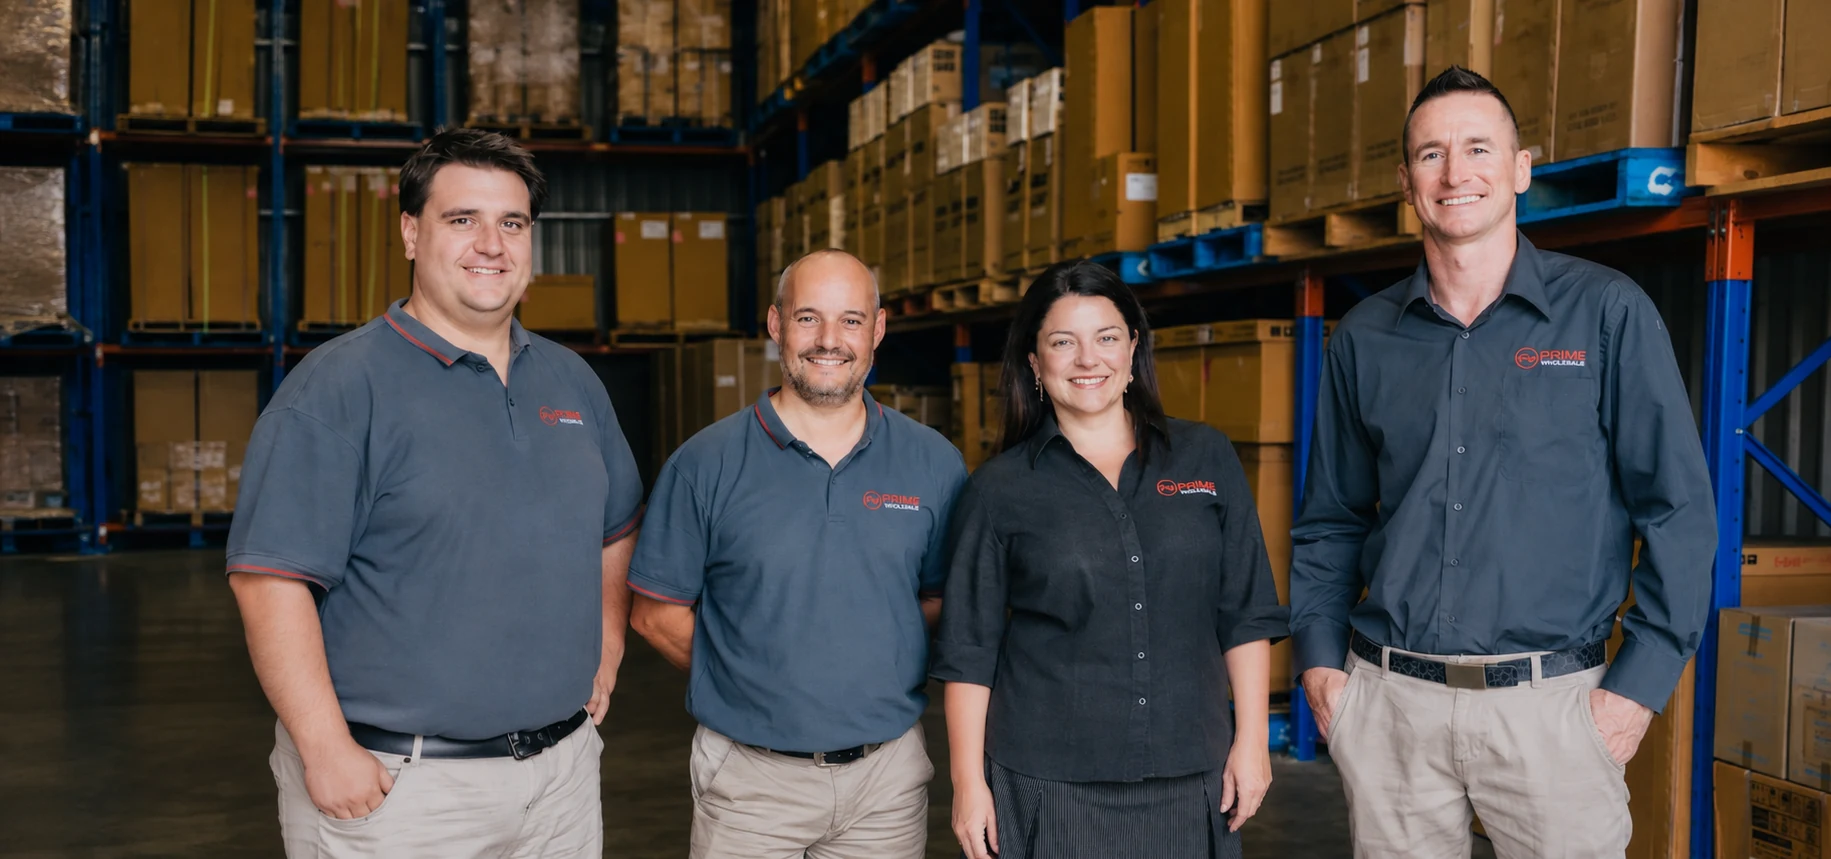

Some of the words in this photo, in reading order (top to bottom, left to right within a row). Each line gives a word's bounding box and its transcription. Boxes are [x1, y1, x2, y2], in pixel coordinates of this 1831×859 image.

[1540, 350, 1586, 361] PRIME
[1178, 480, 1216, 491] PRIME
[882, 493, 920, 506] PRIME
